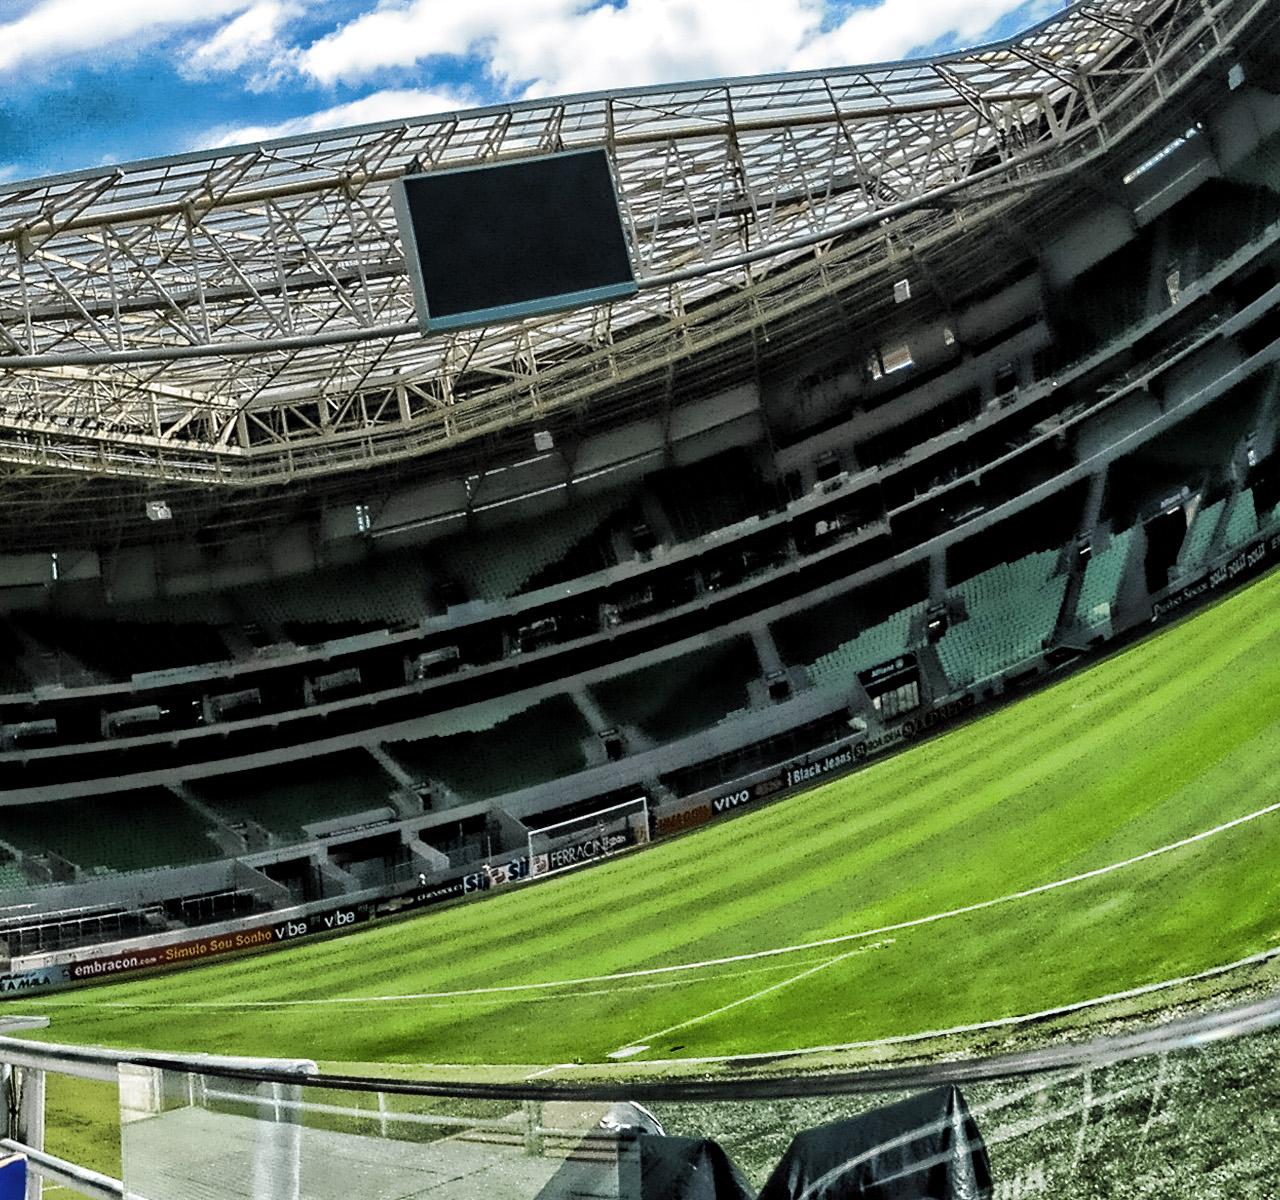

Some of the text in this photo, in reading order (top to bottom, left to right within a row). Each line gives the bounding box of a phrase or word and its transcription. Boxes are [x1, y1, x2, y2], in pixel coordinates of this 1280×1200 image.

[792, 750, 852, 784] Black Jeans
[236, 930, 273, 946] Sonho
